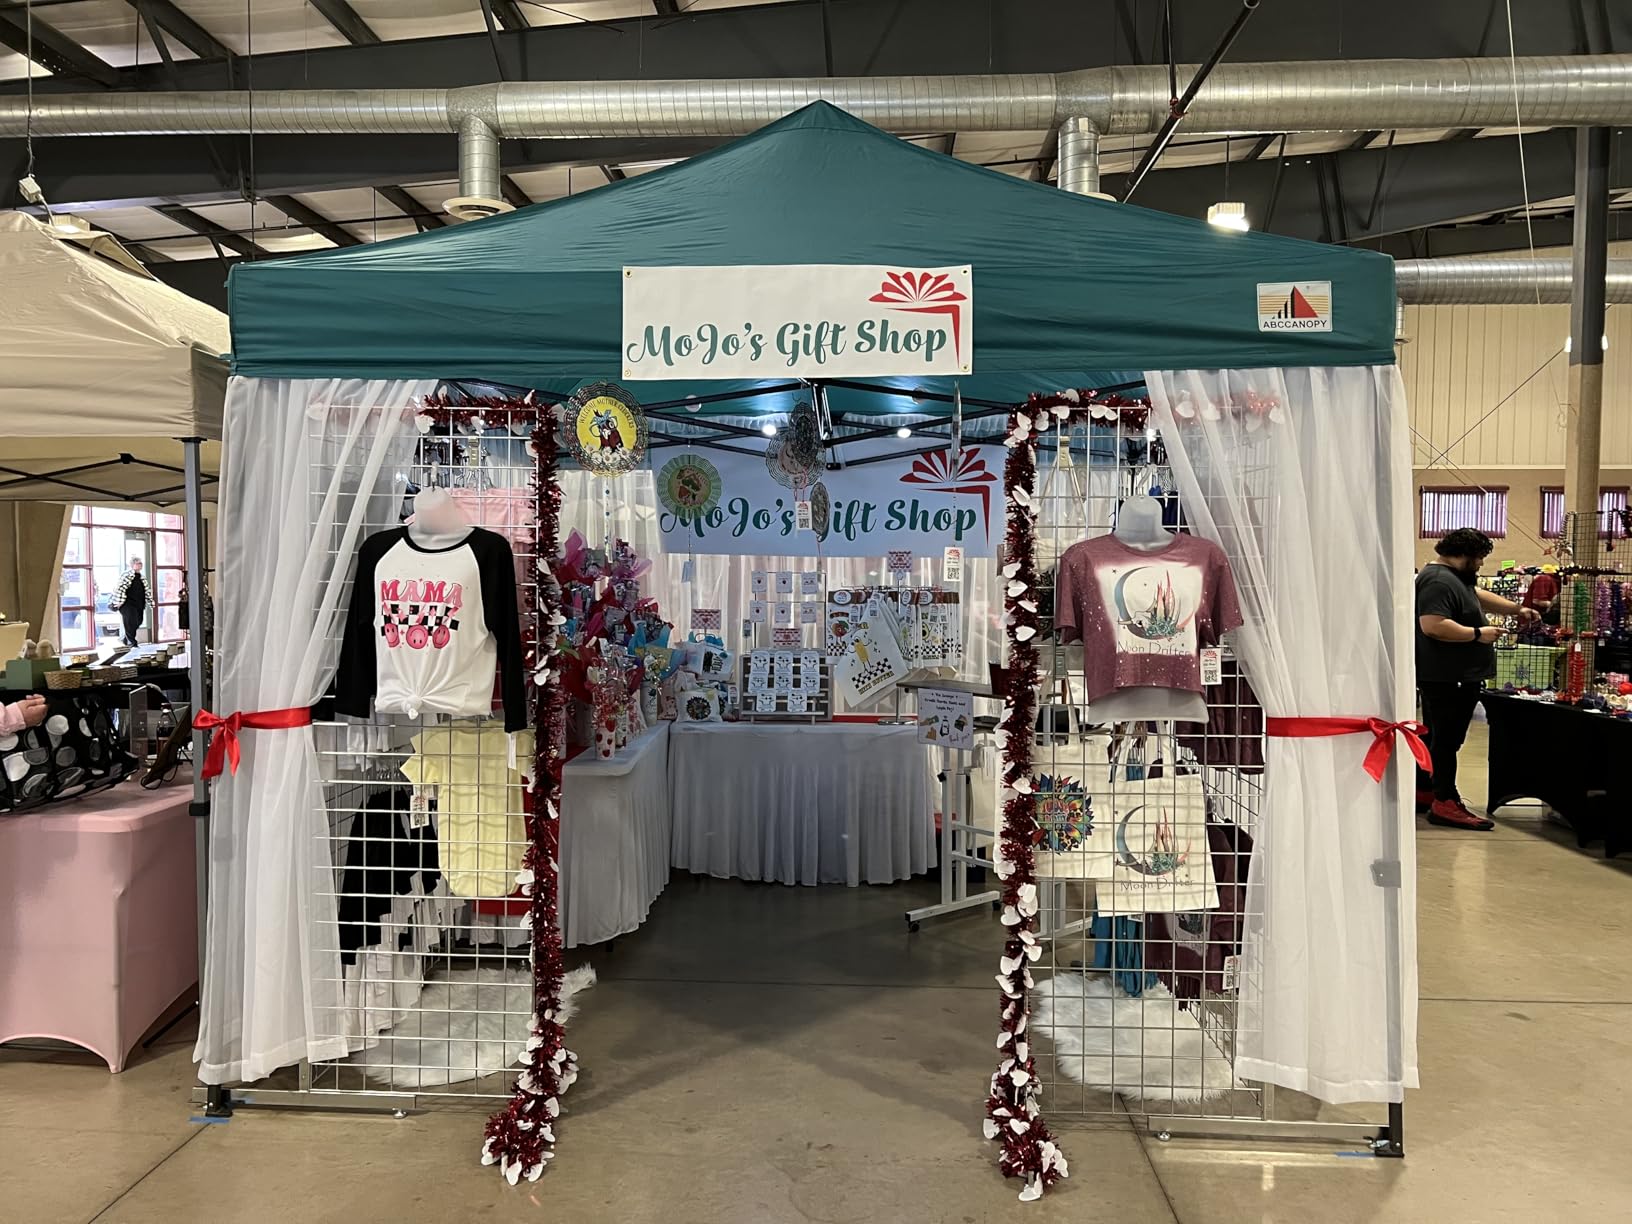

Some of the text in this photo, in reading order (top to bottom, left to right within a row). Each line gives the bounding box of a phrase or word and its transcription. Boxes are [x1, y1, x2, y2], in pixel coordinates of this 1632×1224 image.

[1263, 320, 1327, 329] ABCCANOPY
[627, 319, 947, 366] MoJo's Gift Shop
[812, 499, 877, 542] ift
[885, 499, 977, 541] Shop
[381, 579, 463, 608] MAMA
[1117, 640, 1145, 655] Mon
[1120, 879, 1155, 892] Moon
